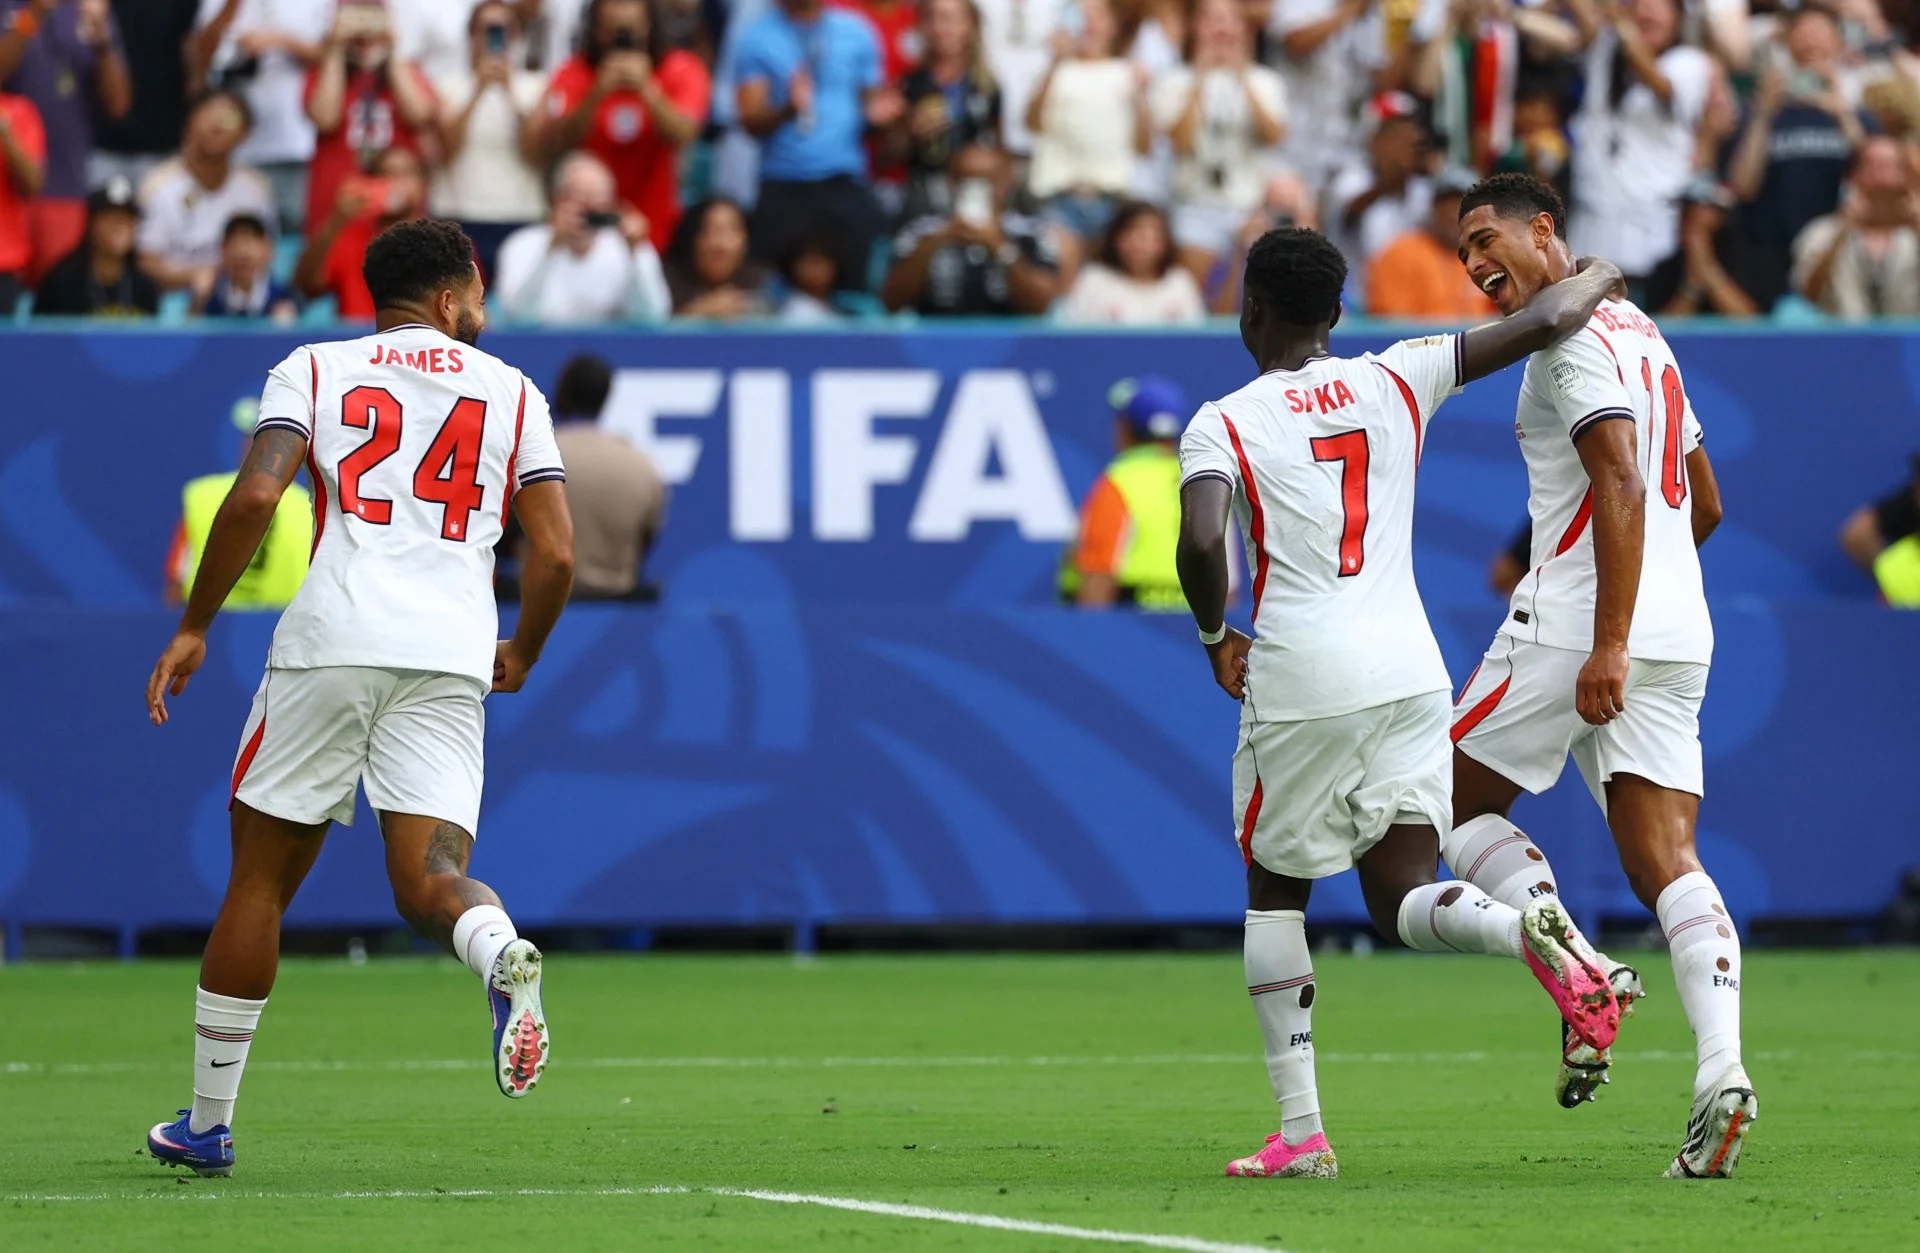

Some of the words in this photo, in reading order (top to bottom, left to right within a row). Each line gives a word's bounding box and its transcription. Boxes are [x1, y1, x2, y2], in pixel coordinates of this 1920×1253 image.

[369, 344, 463, 373] JAMES
[1551, 360, 1571, 374] FOOTBALL
[1552, 365, 1576, 382] UNITES
[1285, 379, 1355, 415] SAKA
[337, 385, 487, 542] 24
[602, 369, 1080, 541] FIFA
[1309, 428, 1370, 577] 7
[1713, 975, 1739, 991] ENG
